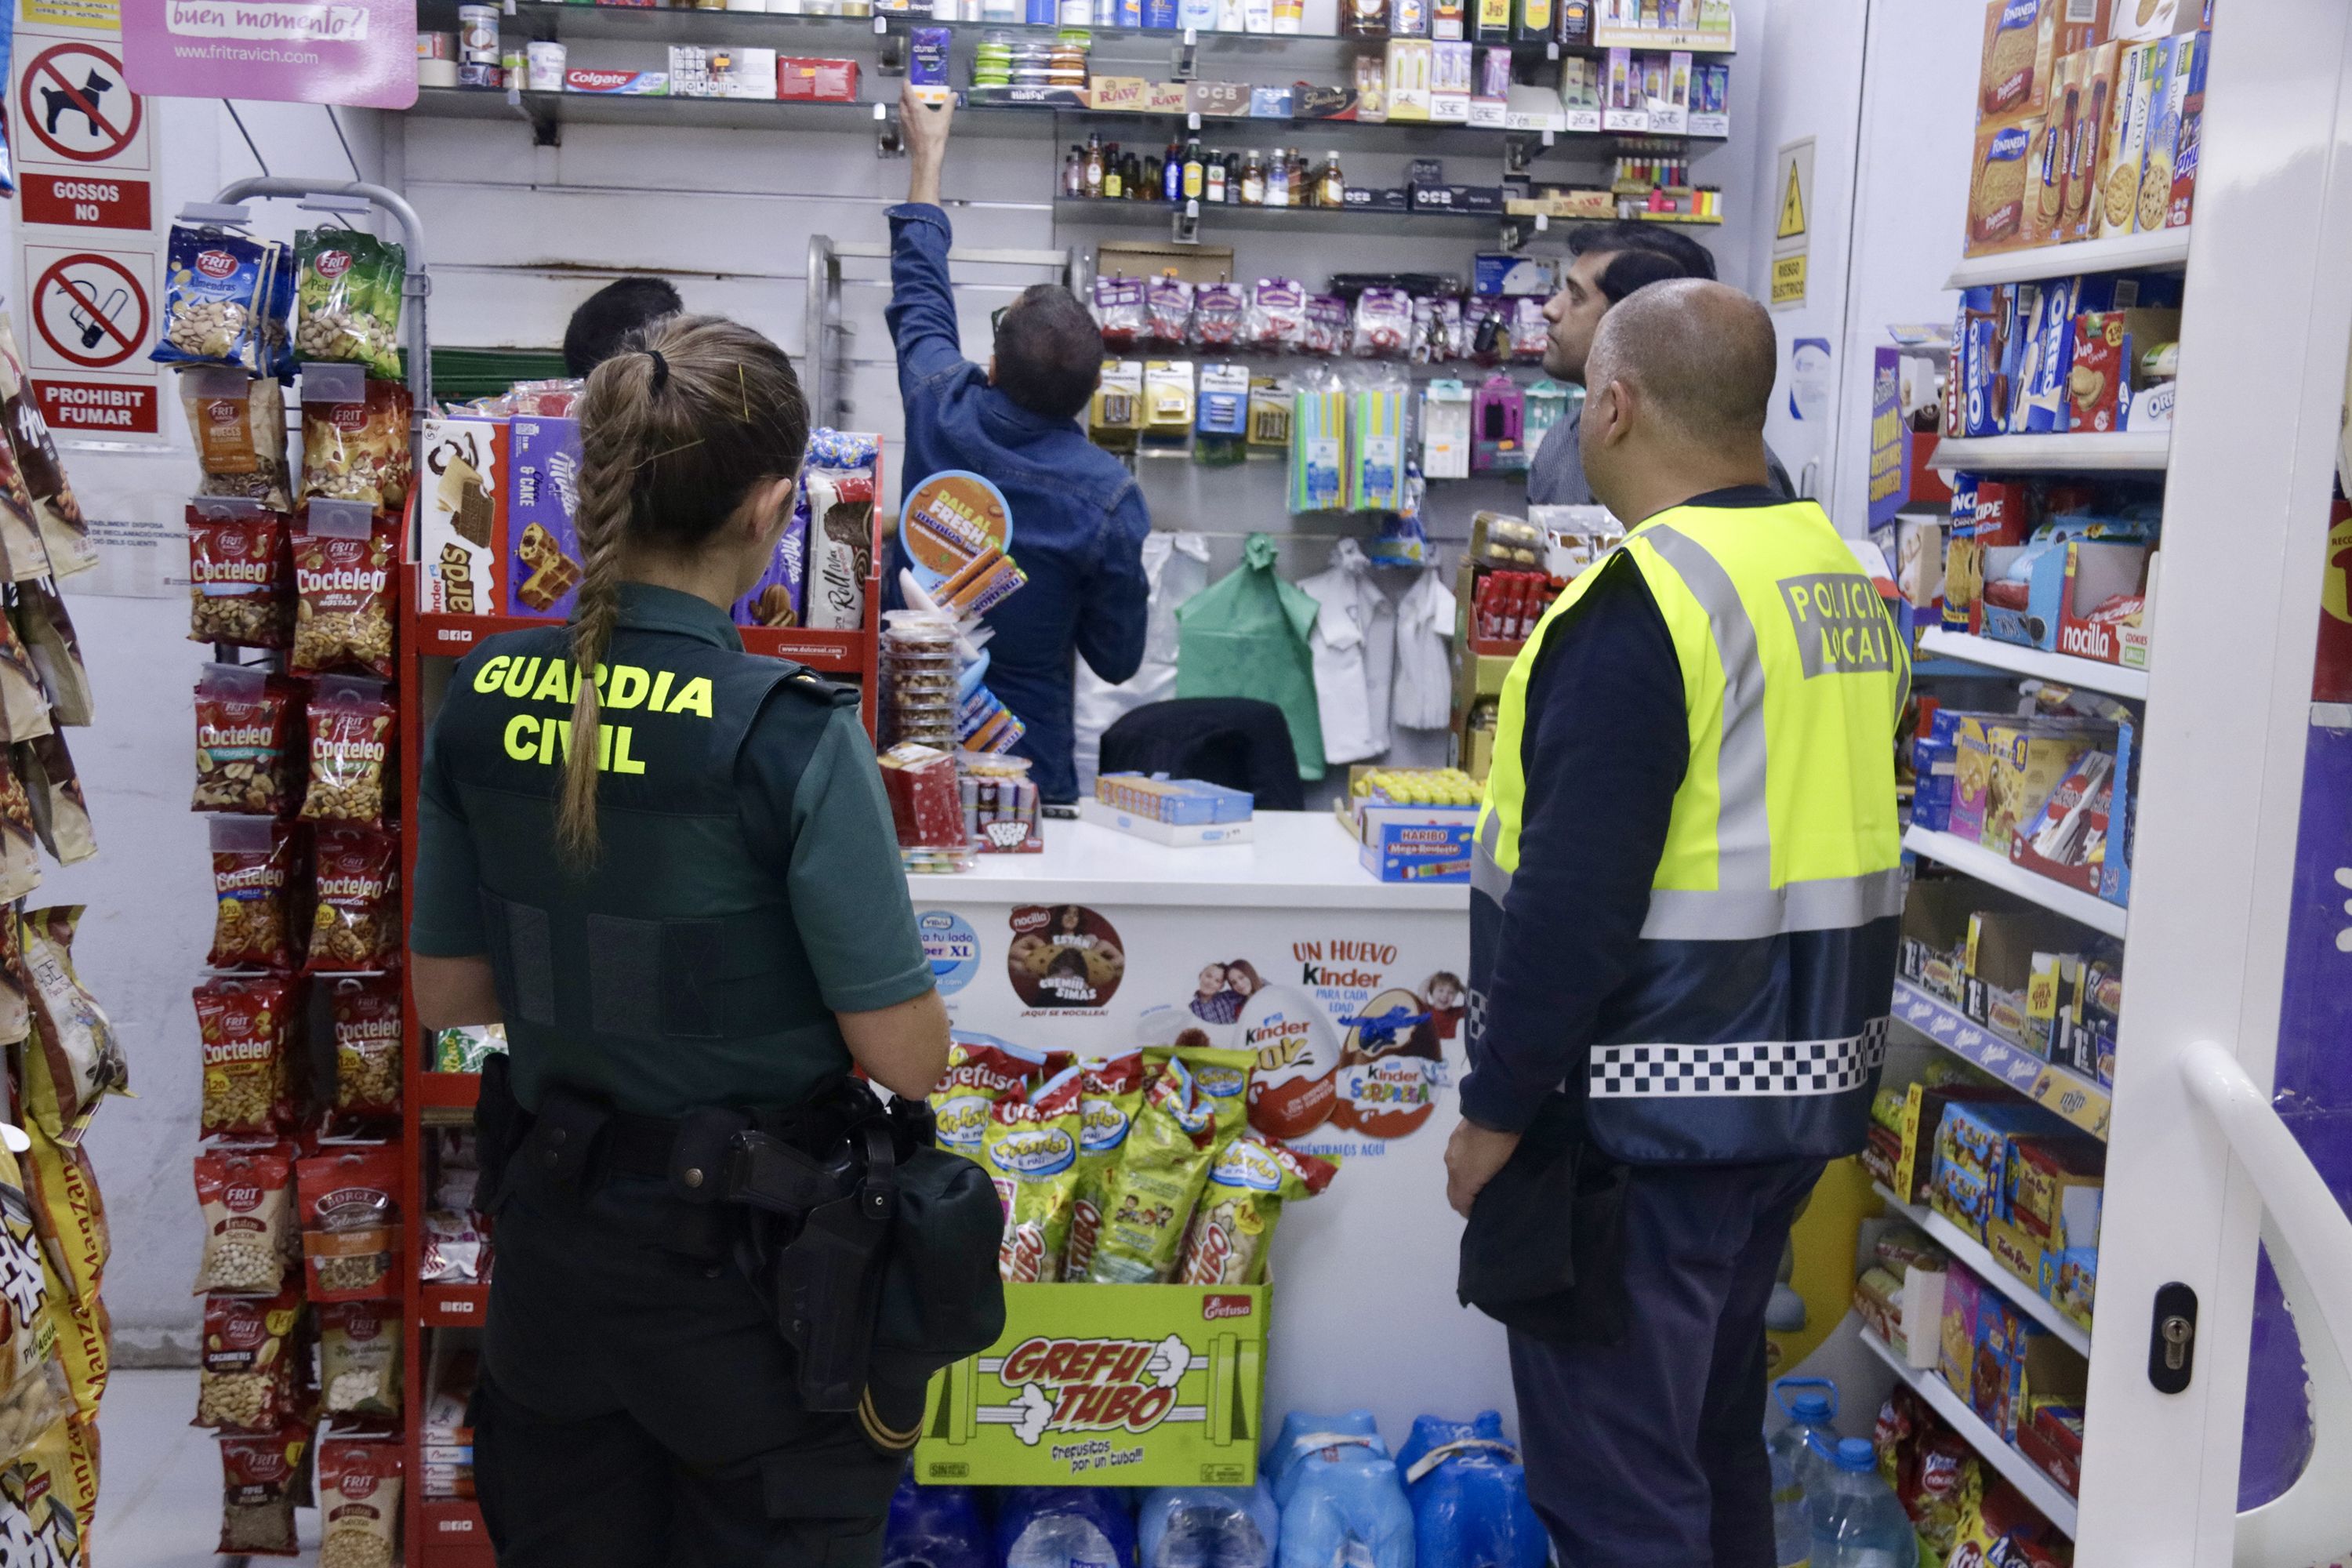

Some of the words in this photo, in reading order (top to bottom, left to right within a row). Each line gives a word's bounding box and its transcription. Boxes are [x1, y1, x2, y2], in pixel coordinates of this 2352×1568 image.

[172, 0, 226, 26] buen
[234, 8, 367, 40] momento!
[2002, 0, 2038, 24] FONTANEDA
[174, 44, 318, 66] www.fritravich.com
[569, 71, 628, 85] Colgate
[1099, 87, 1139, 103] RAW
[1151, 94, 1183, 107] RAW
[1196, 87, 1237, 100] OCB
[1991, 132, 2027, 156] FONTANEDA
[2085, 121, 2096, 169] Digestive
[53, 181, 119, 203] GOSSOS
[1345, 191, 1371, 201] OCB
[1417, 190, 1452, 204] OCB
[75, 203, 100, 222] NO
[201, 253, 234, 267] FRIT
[319, 253, 348, 267] FRIT
[2041, 287, 2067, 396] OREO
[1968, 317, 1984, 427] OREO
[1205, 378, 1244, 387] Panasonic
[45, 387, 144, 408] PROHIBIT
[1254, 390, 1291, 399] Panasonic
[59, 405, 132, 426] FUMAR
[212, 403, 234, 416] FRIT
[335, 409, 363, 422] FRIT
[2148, 394, 2174, 419] ORE
[520, 478, 535, 507] CAKE
[550, 452, 577, 517] Milka
[938, 489, 974, 521] DALE
[974, 514, 993, 532] AL
[915, 510, 964, 546] mentos
[928, 500, 987, 544] FRESH
[220, 535, 244, 546] FRIT
[330, 542, 358, 552] FRIT
[781, 532, 802, 585] Milka
[192, 559, 267, 583] Cocteleo
[297, 568, 387, 594] Cocteleo
[438, 543, 475, 614] ards
[431, 579, 441, 614] inder
[822, 569, 856, 611] Roll
[1788, 582, 1886, 622] POLICIA
[2063, 622, 2109, 659] nocilla
[2125, 633, 2148, 645] COOKIES
[474, 655, 713, 718] GUARDIA
[199, 724, 273, 749] Cocteleo
[212, 749, 255, 758] TROPICAL
[313, 737, 385, 762] Cocteleo
[986, 822, 1029, 837] PUSH
[993, 830, 1027, 848] POP
[1402, 829, 1447, 841] HARIBO
[216, 869, 285, 891] Cocteleo
[316, 876, 383, 899] Cocteleo
[1014, 912, 1047, 927] nocilla
[933, 933, 945, 942] tu
[948, 931, 973, 942] lado
[949, 945, 973, 958] XL
[1293, 941, 1323, 963] UN
[1330, 939, 1398, 965] HUEVO
[1055, 986, 1098, 1001] SIMAS
[1316, 989, 1341, 1001] PARA
[1343, 989, 1369, 1002] CADA
[1062, 1009, 1109, 1018] NOCILLEA!
[1329, 1002, 1355, 1014] EDAD
[225, 1016, 249, 1027] FRIT
[336, 1018, 401, 1040] Cocteleo
[203, 1038, 272, 1065] Cocteleo
[1255, 1036, 1308, 1072] OY
[1360, 1141, 1387, 1156] AQUÍ
[227, 1188, 258, 1200] FRIT
[327, 1190, 379, 1207] BORGES
[1203, 1300, 1252, 1320] Grefusa
[228, 1320, 260, 1332] FRIT
[1003, 1338, 1156, 1385] GREFU
[1052, 1384, 1174, 1428] TUBO
[249, 1454, 281, 1465] FRIT
[1071, 1456, 1097, 1475] por
[1094, 1455, 1108, 1471] un
[1110, 1447, 1144, 1465] tubo!!!
[930, 1465, 948, 1476] SIN
[342, 1475, 372, 1487] FRIT
